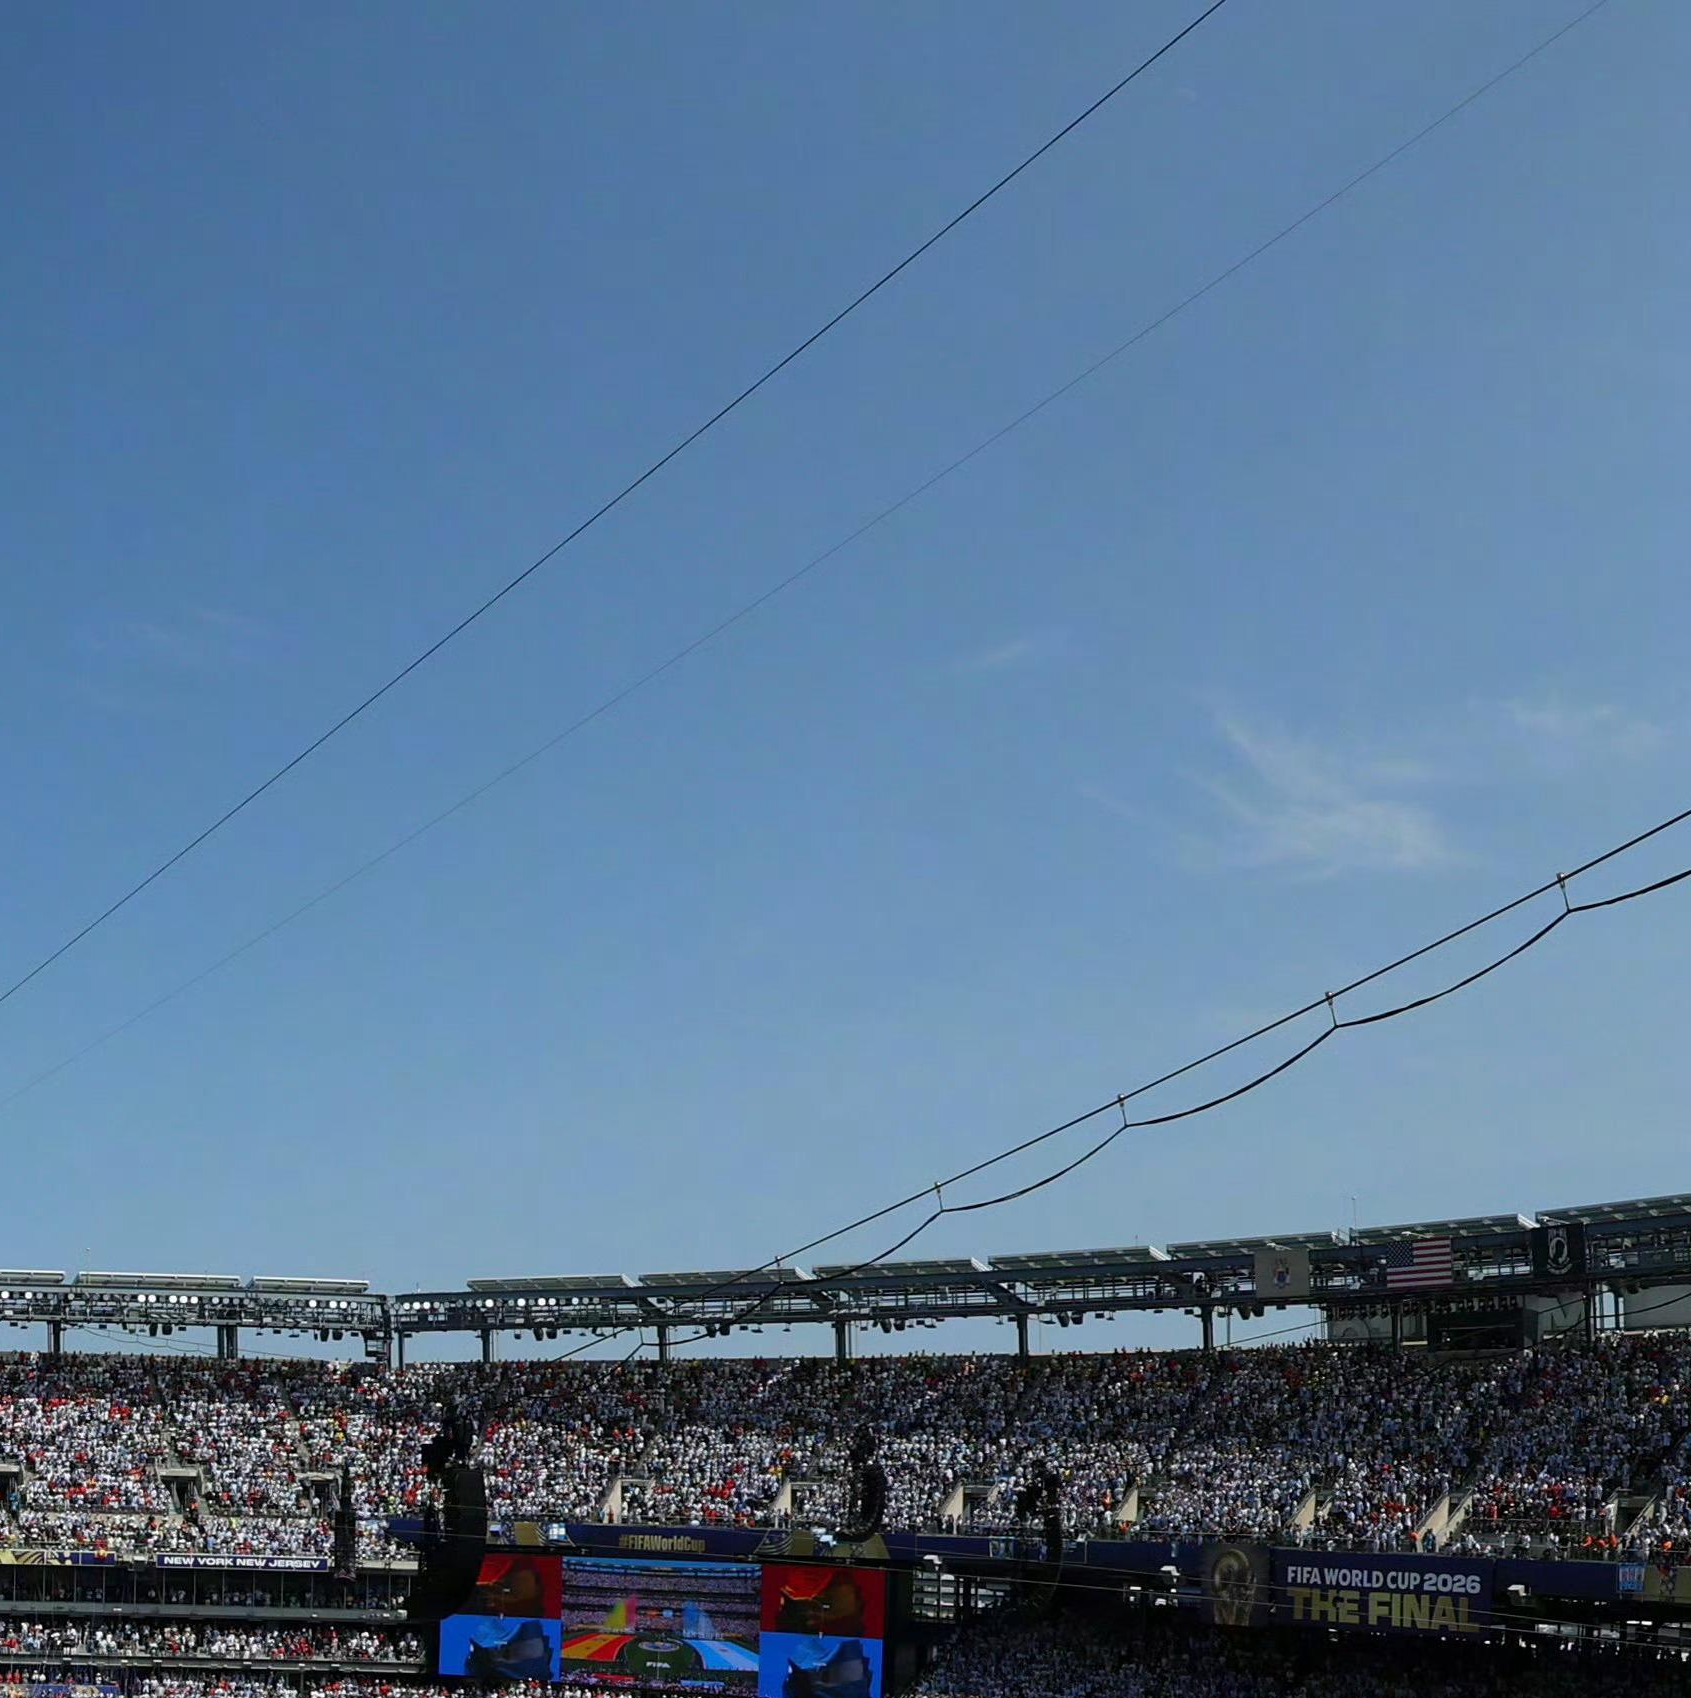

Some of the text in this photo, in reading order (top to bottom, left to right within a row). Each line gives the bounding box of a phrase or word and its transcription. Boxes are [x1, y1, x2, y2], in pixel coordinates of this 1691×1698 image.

[618, 1534, 706, 1552] #FIFAWorldCup
[163, 1556, 320, 1568] NEW YORK NEW JERSEY
[1286, 1565, 1482, 1595] FIFA WORLD CUP 2026
[1286, 1585, 1481, 1634] THE FINAL
